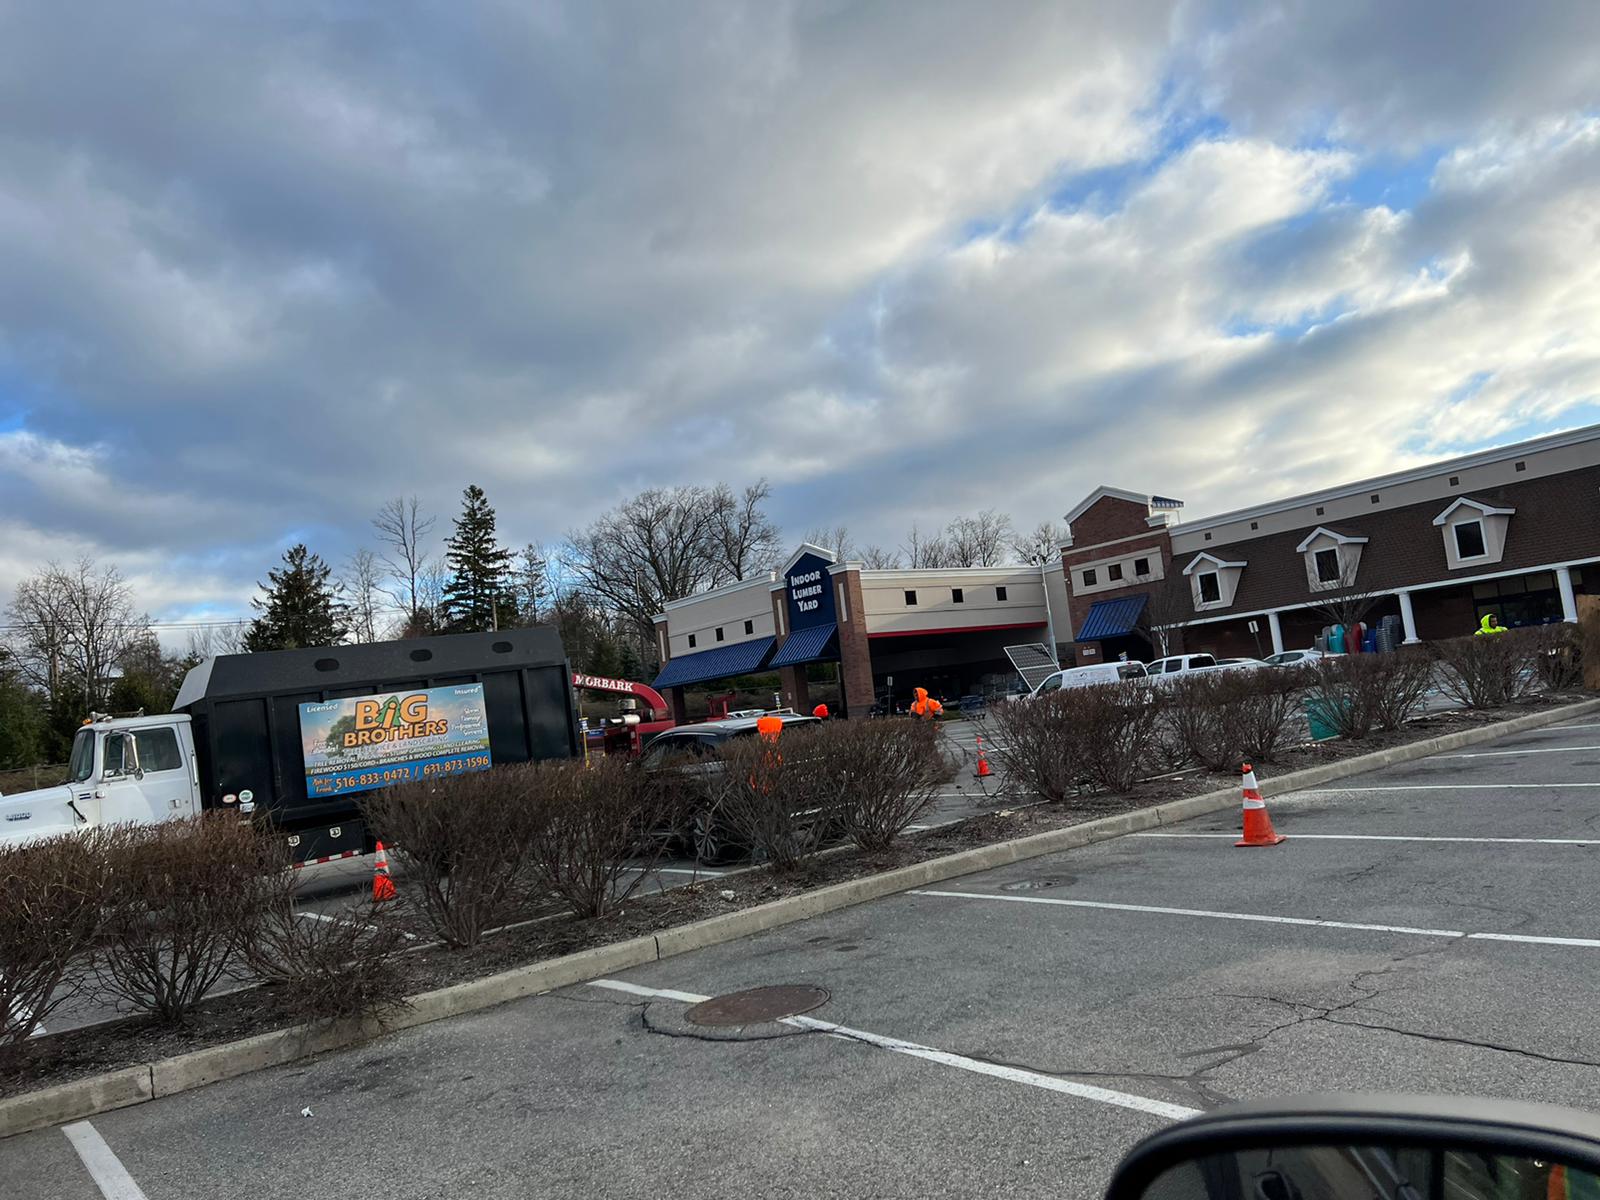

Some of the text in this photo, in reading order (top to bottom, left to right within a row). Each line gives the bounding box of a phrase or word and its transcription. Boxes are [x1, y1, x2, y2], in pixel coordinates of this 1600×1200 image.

[454, 686, 478, 695] Insured
[575, 674, 634, 692] MORBARK
[306, 703, 338, 713] Licensed
[344, 719, 448, 748] BROTHERS
[335, 767, 410, 789] 516-833-0472
[423, 755, 488, 775] 631-873-1596
